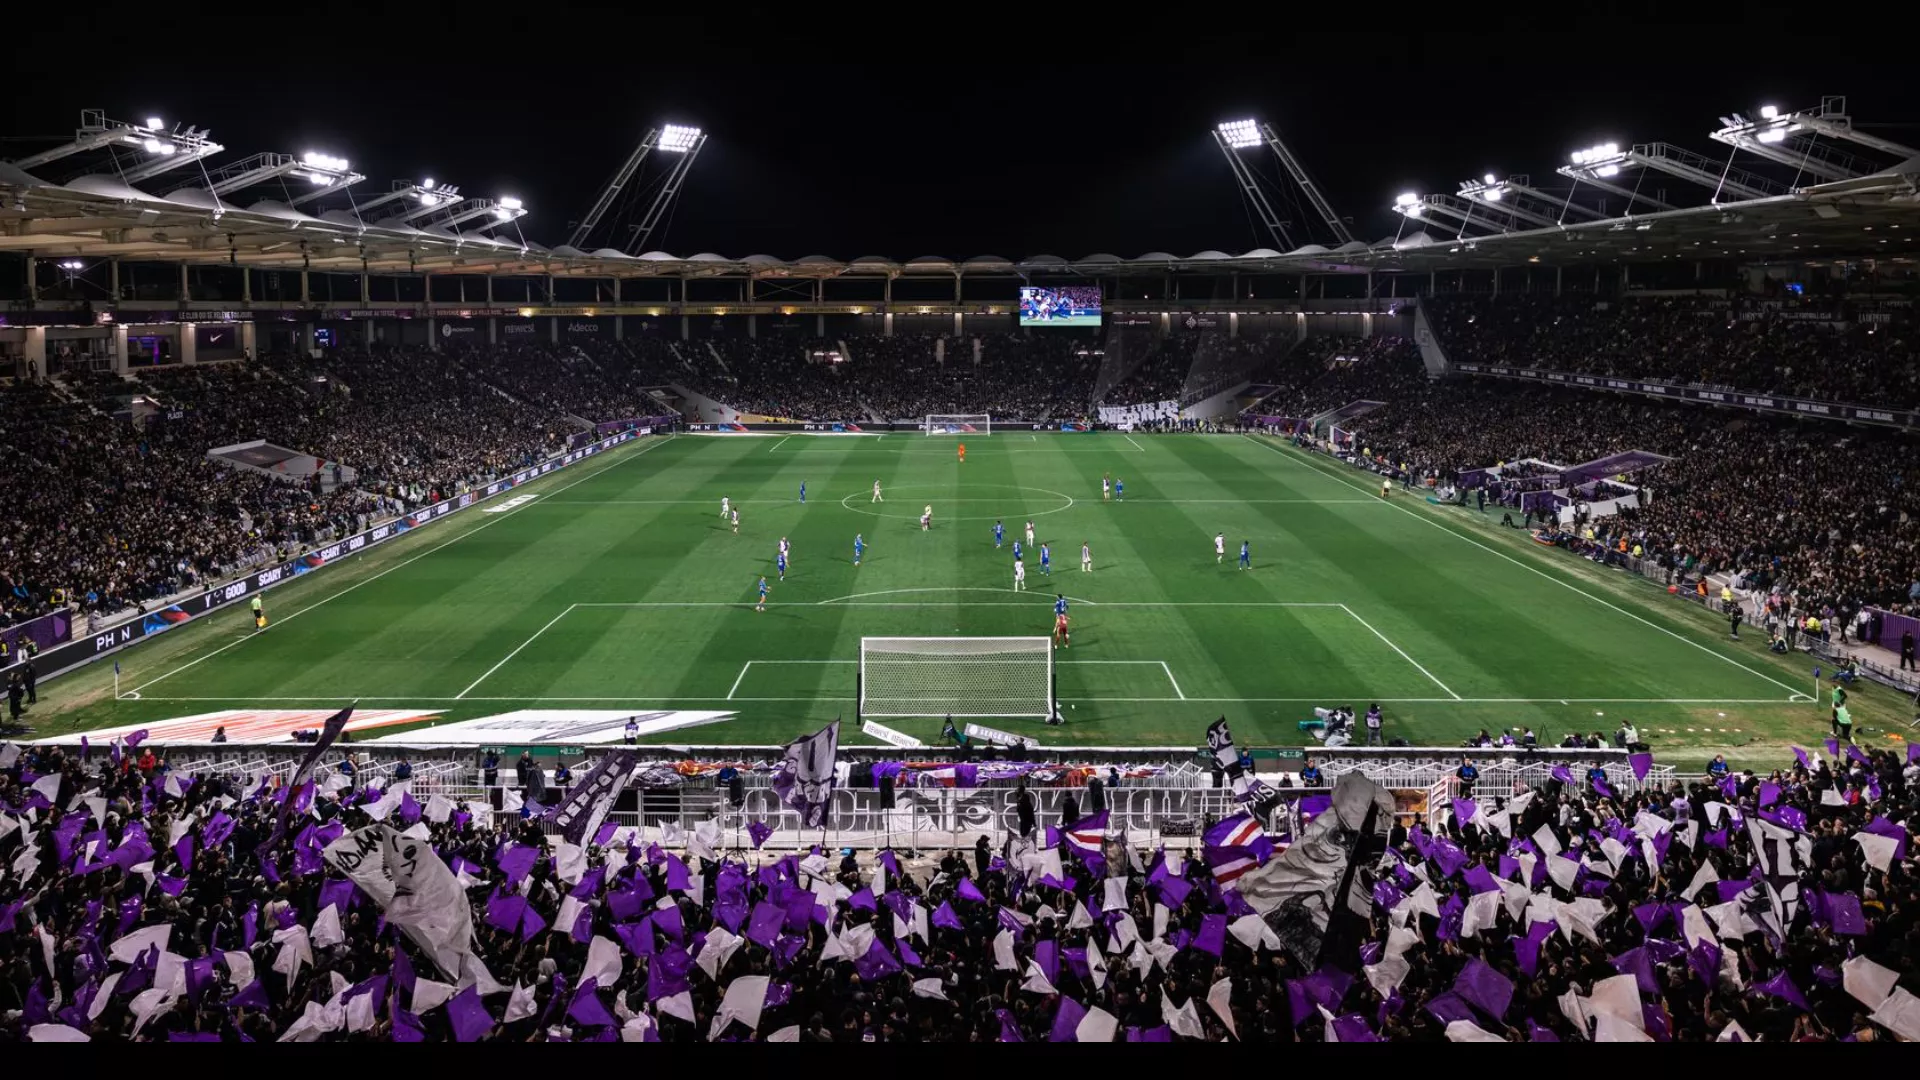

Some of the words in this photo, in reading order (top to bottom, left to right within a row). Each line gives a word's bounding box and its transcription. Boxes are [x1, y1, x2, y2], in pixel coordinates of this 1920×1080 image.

[568, 323, 599, 333] Adecco
[372, 526, 389, 541] SCARY
[320, 545, 340, 560] SCARY
[349, 535, 365, 550] GOOD
[258, 567, 282, 586] SCARY
[225, 581, 247, 599] GOOD
[96, 633, 114, 650] PH
[121, 627, 130, 640] N
